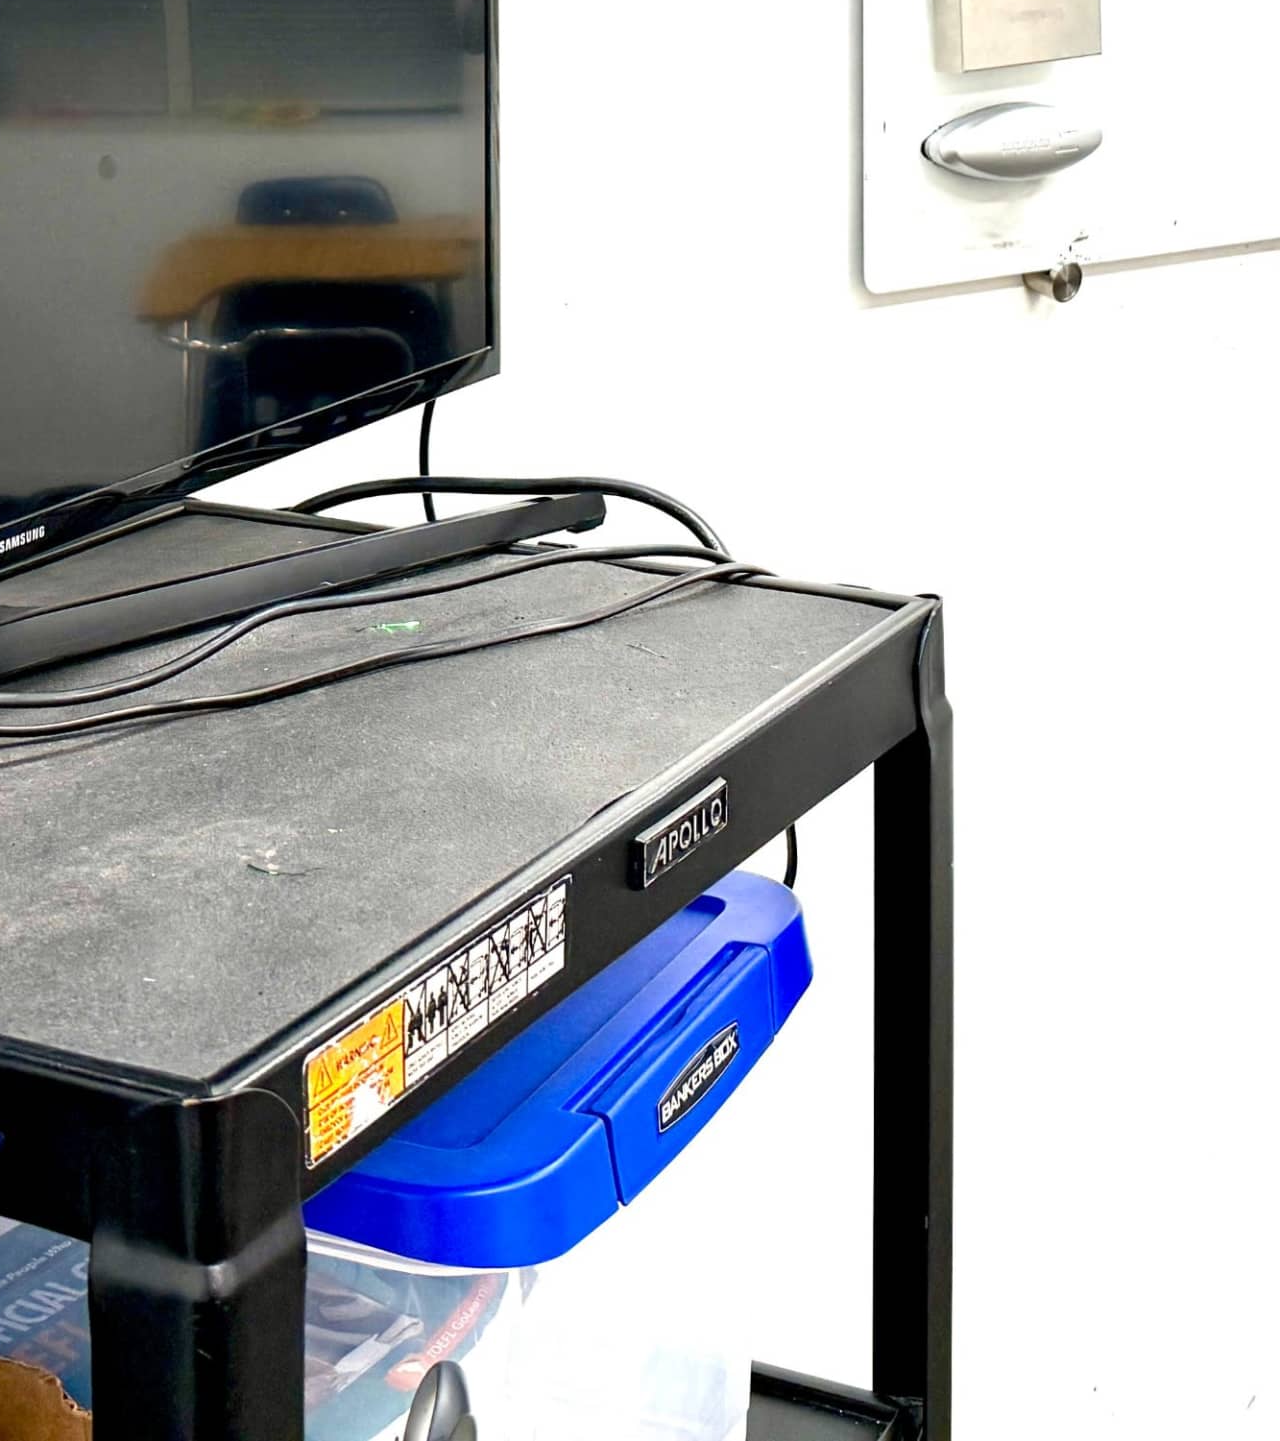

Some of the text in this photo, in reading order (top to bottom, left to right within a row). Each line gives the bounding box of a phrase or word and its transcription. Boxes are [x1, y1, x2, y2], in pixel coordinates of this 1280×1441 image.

[649, 798, 722, 874] APOLLO
[661, 1031, 738, 1124] BANKERS BOX
[6, 1255, 47, 1281] People
[427, 1330, 457, 1359] TOEFL
